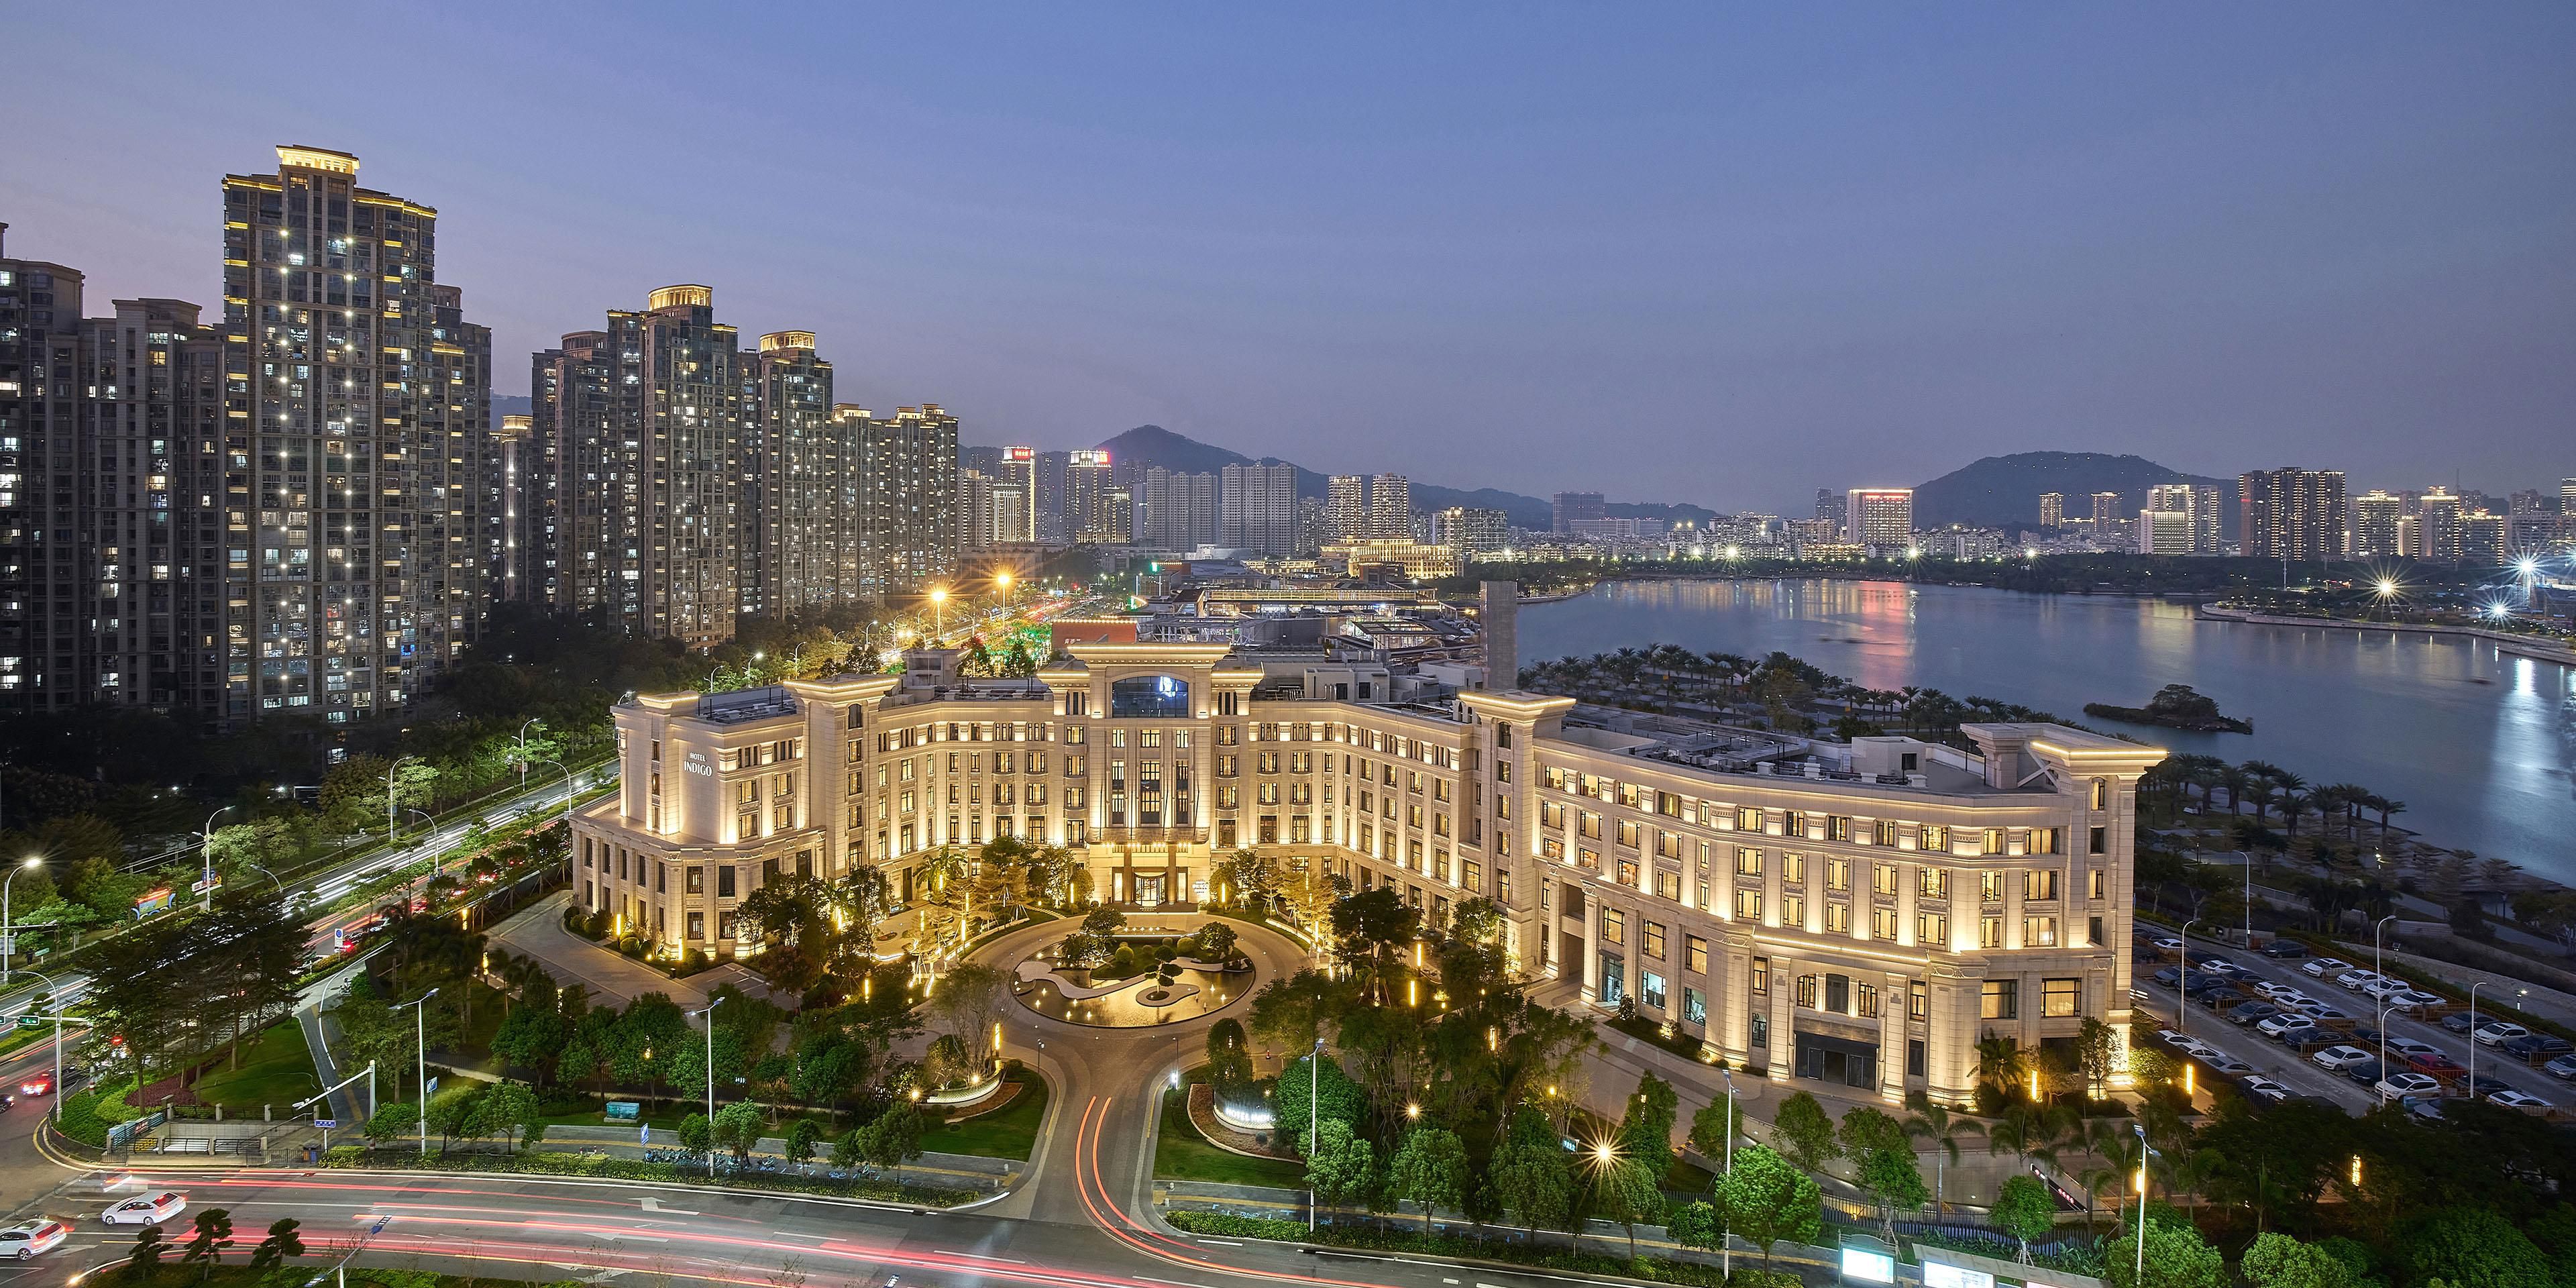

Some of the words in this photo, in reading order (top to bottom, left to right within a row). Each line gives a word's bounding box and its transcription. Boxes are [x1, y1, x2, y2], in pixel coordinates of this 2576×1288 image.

[690, 752, 706, 761] HOTEL
[684, 761, 712, 777] INDIGO
[1226, 1108, 1250, 1121] HOTEL
